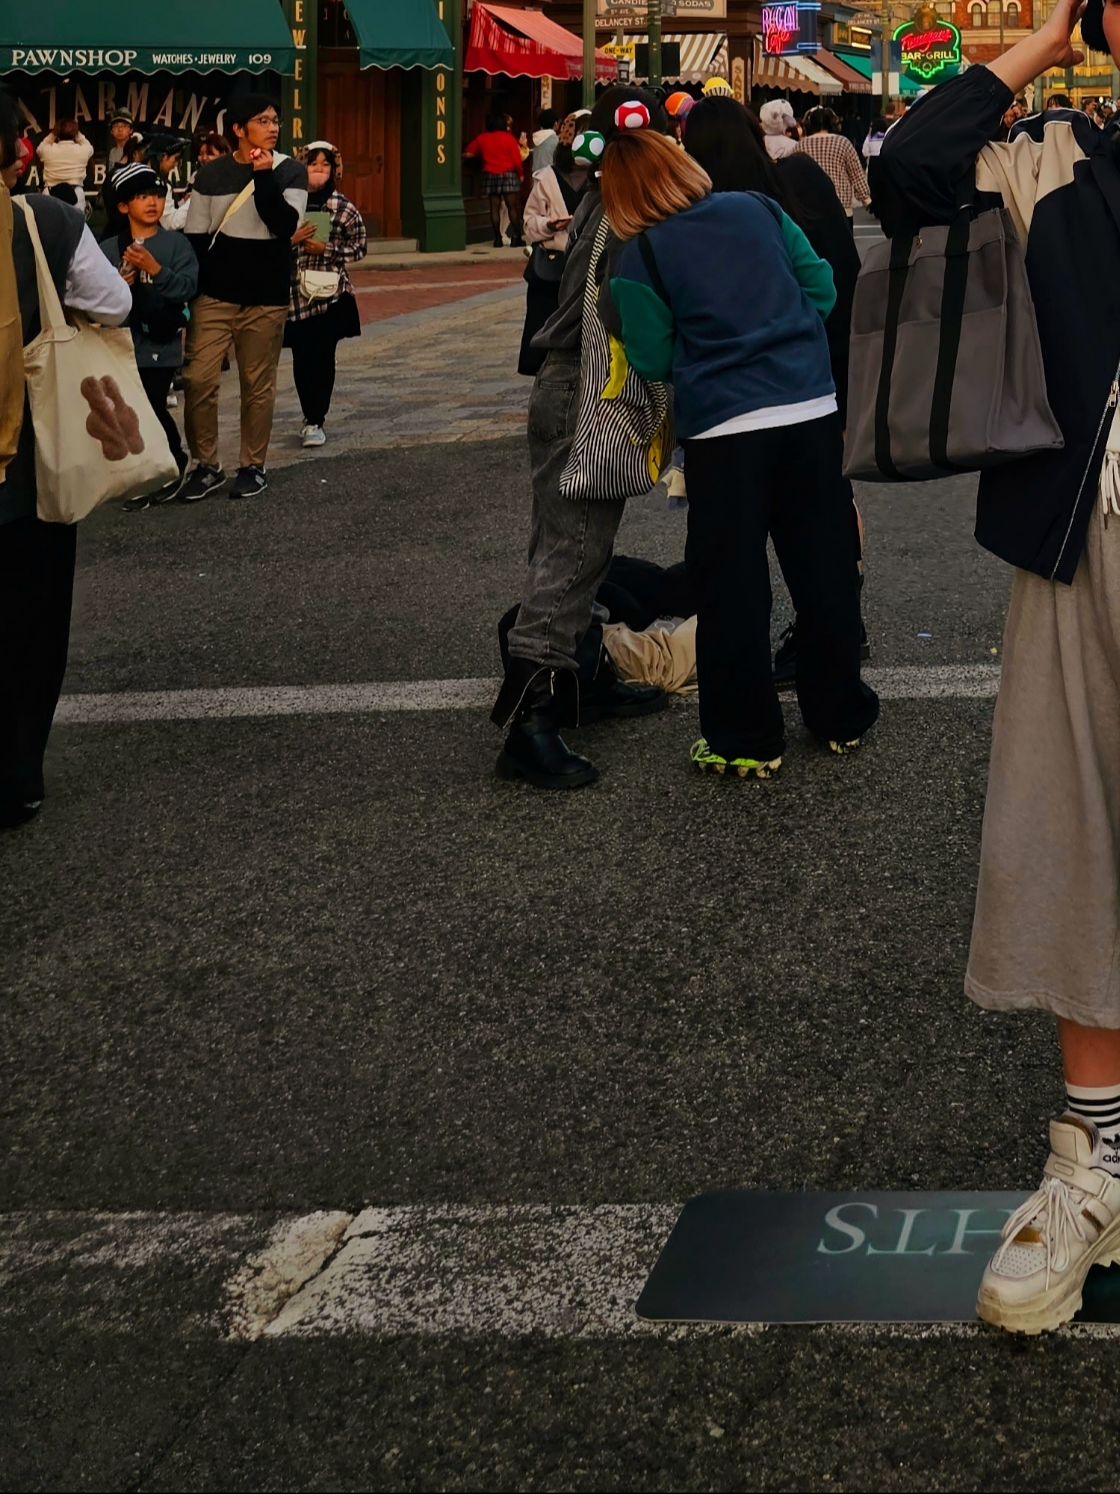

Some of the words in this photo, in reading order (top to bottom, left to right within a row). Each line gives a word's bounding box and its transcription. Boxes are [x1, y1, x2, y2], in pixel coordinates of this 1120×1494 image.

[678, 0, 711, 8] SODAS
[594, 17, 632, 27] DELANCEY
[635, 16, 646, 25] ST.
[11, 49, 137, 66] PAWNSHOP
[152, 53, 194, 65] WATCHES
[198, 52, 237, 64] JEWELRY
[248, 53, 272, 64] 109
